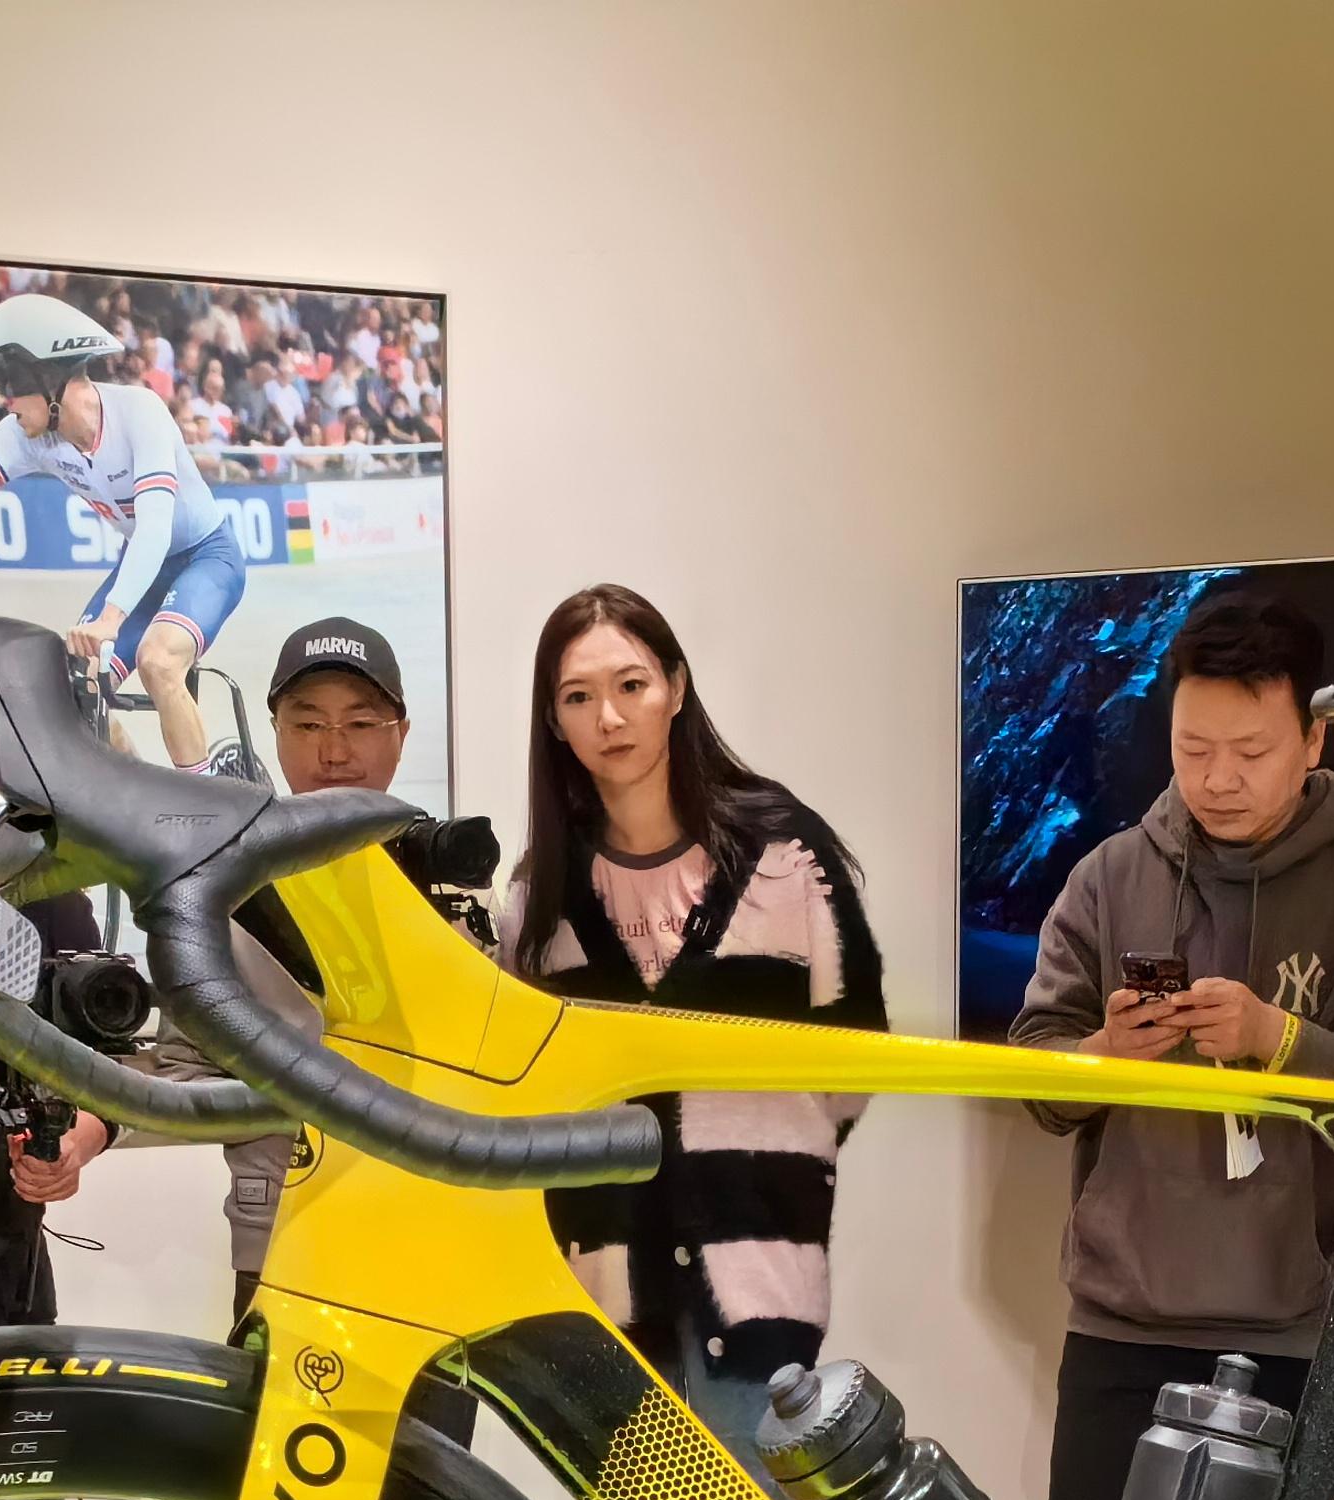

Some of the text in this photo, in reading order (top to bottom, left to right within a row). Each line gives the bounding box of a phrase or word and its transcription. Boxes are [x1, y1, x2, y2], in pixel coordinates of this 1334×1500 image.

[51, 335, 109, 353] LAZER
[305, 636, 368, 661] MARVEL
[13, 1410, 55, 1423] ARC
[27, 1470, 55, 1483] DT
